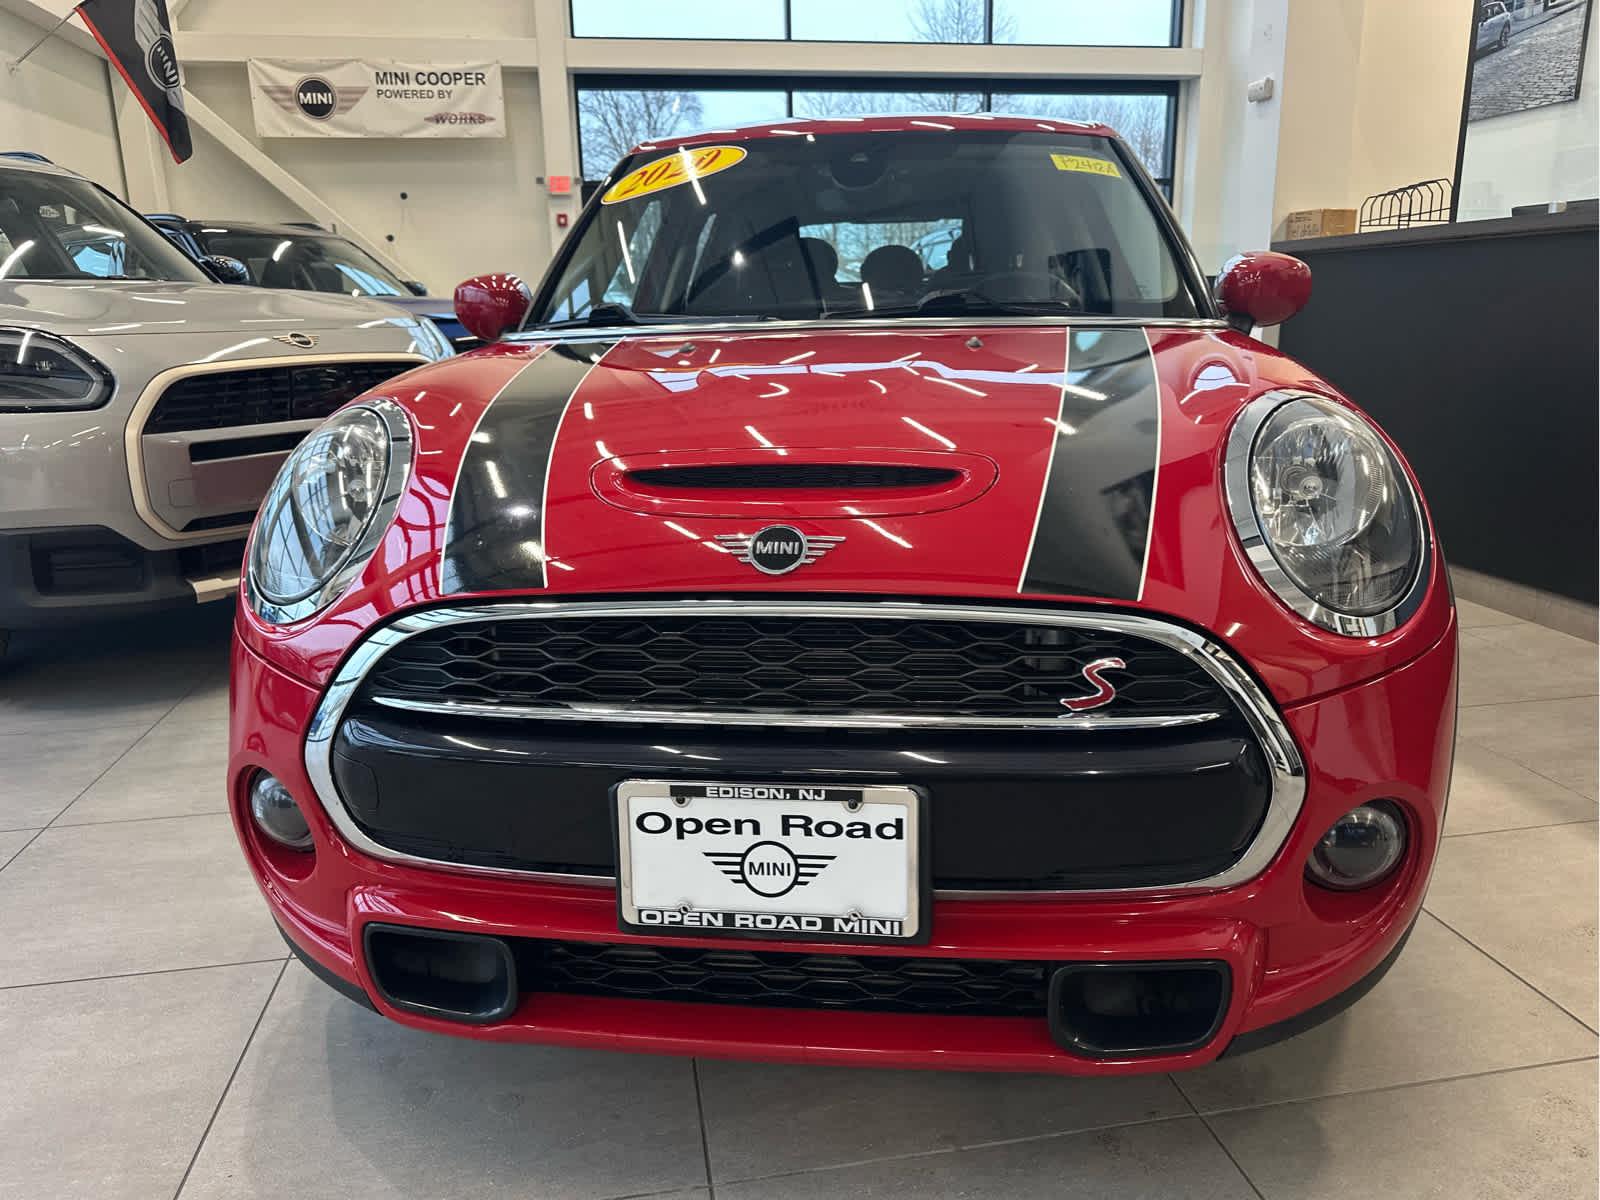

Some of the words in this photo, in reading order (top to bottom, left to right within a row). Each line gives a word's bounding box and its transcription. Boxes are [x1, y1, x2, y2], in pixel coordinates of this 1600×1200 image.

[375, 71, 410, 86] MINI
[415, 71, 487, 86] COOPER
[299, 91, 333, 105] MINI
[376, 89, 435, 100] POWERED
[437, 89, 453, 100] BY
[755, 540, 800, 555] MINI
[1060, 657, 1126, 711] S
[705, 786, 792, 800] EDISON,
[798, 789, 826, 801] NJ
[635, 811, 762, 840] Open
[780, 814, 904, 841] Road
[748, 861, 791, 877] MINI
[640, 910, 724, 927] OPEN
[734, 914, 823, 932] ROAD
[833, 917, 900, 935] MINI
